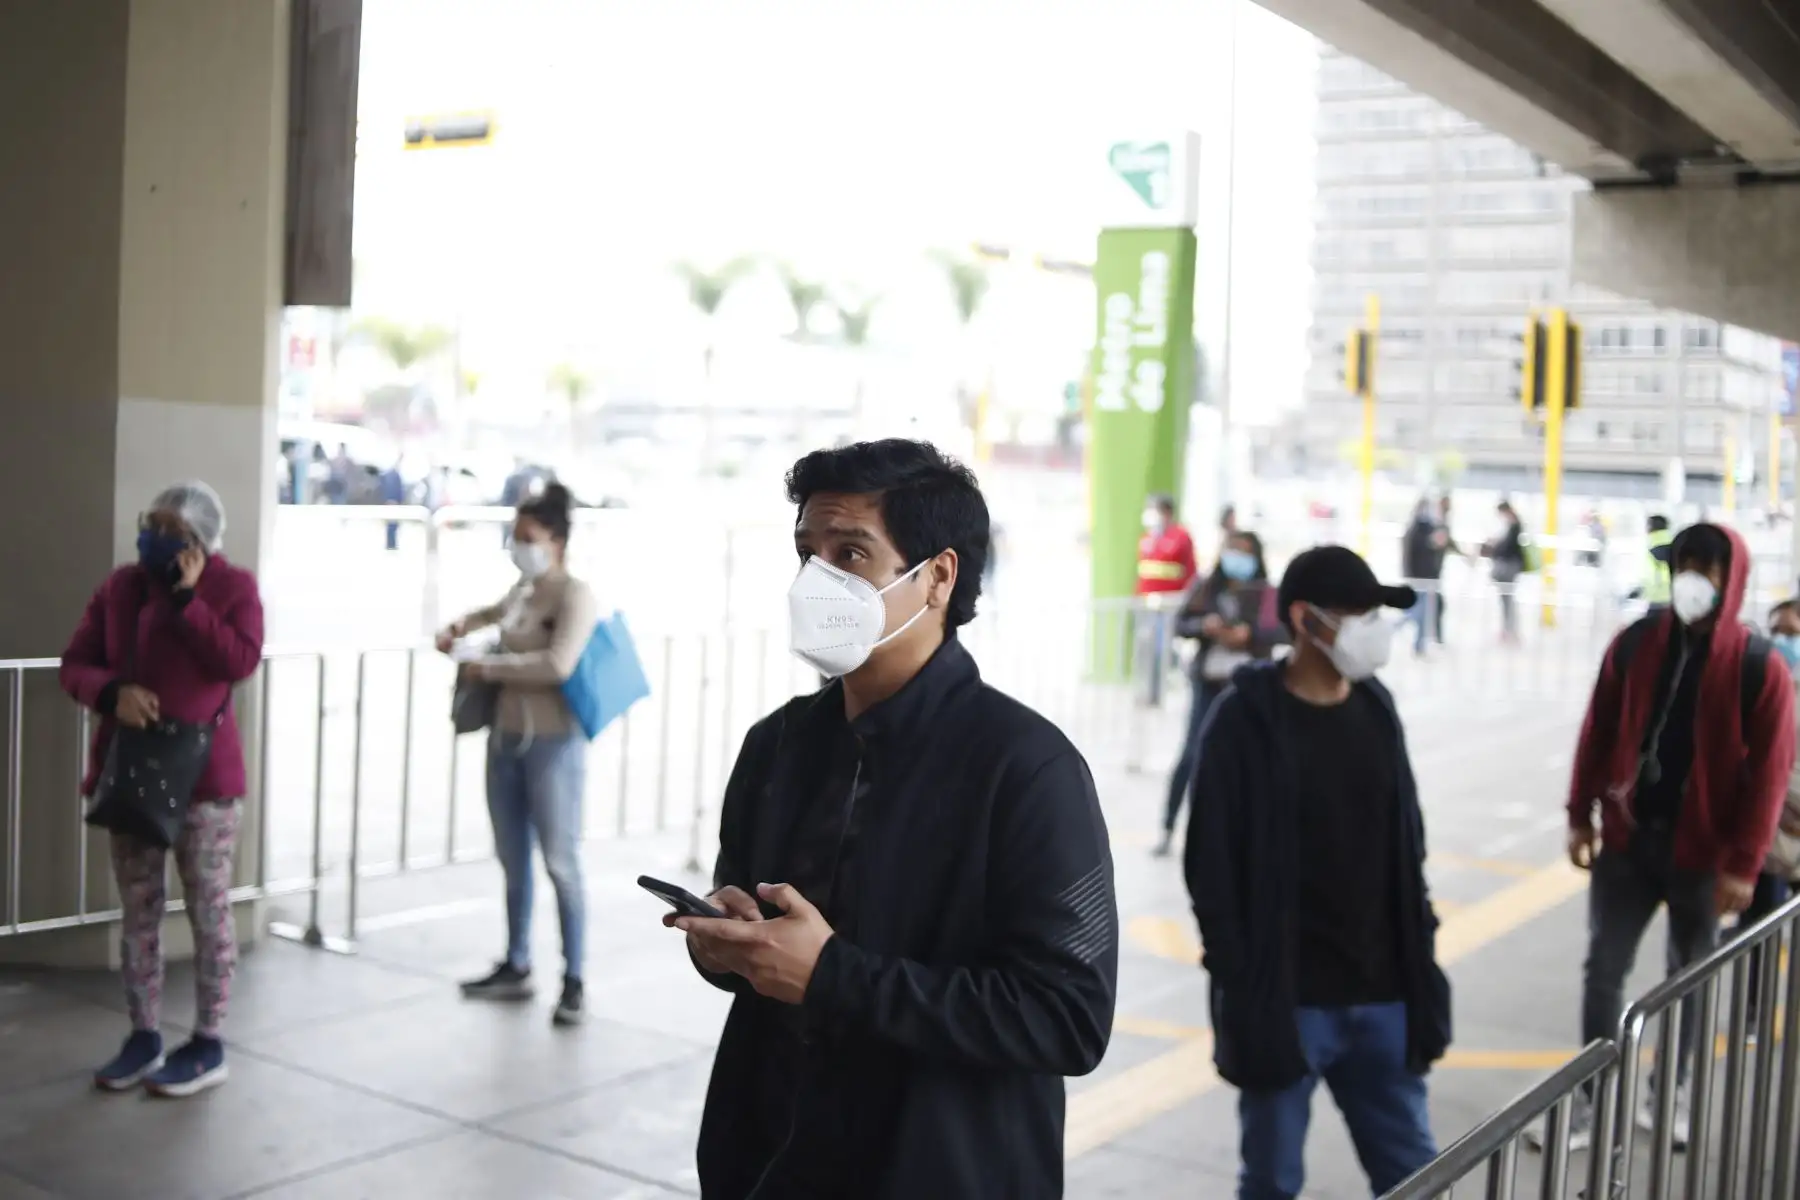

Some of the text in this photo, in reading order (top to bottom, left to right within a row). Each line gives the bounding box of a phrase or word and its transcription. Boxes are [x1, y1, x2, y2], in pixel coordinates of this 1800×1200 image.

[1096, 293, 1133, 411] Metro
[1131, 251, 1169, 413] de Lima
[827, 615, 853, 623] KN95
